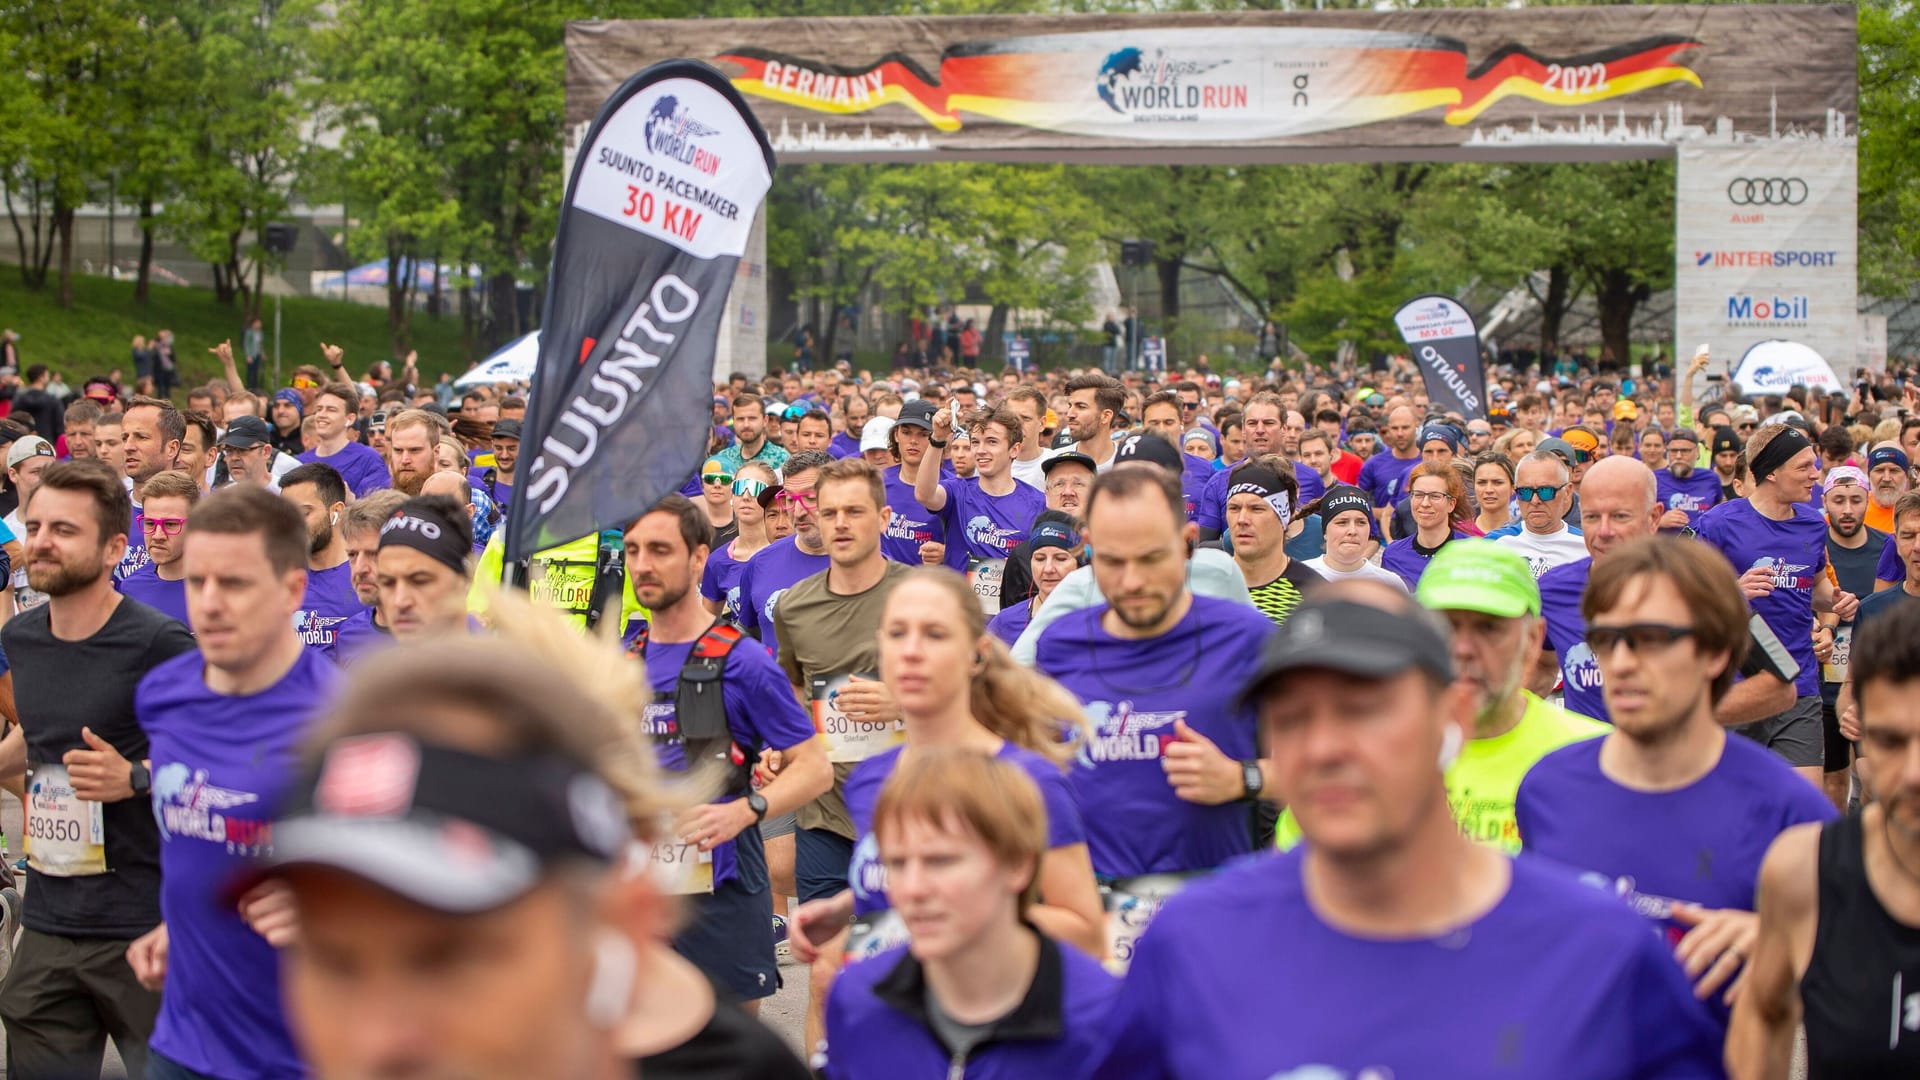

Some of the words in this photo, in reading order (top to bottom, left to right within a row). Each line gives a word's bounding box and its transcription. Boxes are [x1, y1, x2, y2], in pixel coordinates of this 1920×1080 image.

[763, 59, 886, 105] GERMANY
[1543, 62, 1610, 96] 2022
[1122, 85, 1200, 108] WORLD
[1202, 84, 1248, 108] RUN
[654, 129, 697, 165] WORLD
[693, 147, 721, 177] RUN
[598, 146, 654, 183] SUUNTO
[656, 170, 739, 221] PACEMAKER
[623, 184, 655, 223] 30
[663, 199, 703, 242] KM
[1730, 213, 1764, 224] Audi
[1714, 251, 1837, 267] INTERSPORT
[1728, 296, 1808, 319] Mobil
[526, 273, 700, 515] SUUNTO
[887, 526, 915, 540] WORLD
[915, 531, 932, 541] RUN
[977, 531, 1007, 549] WORLD
[575, 587, 593, 602] RU
[296, 630, 333, 645] WORLD
[1091, 733, 1160, 761] WORLD
[28, 815, 81, 842] 59350
[163, 805, 227, 843] WORLD
